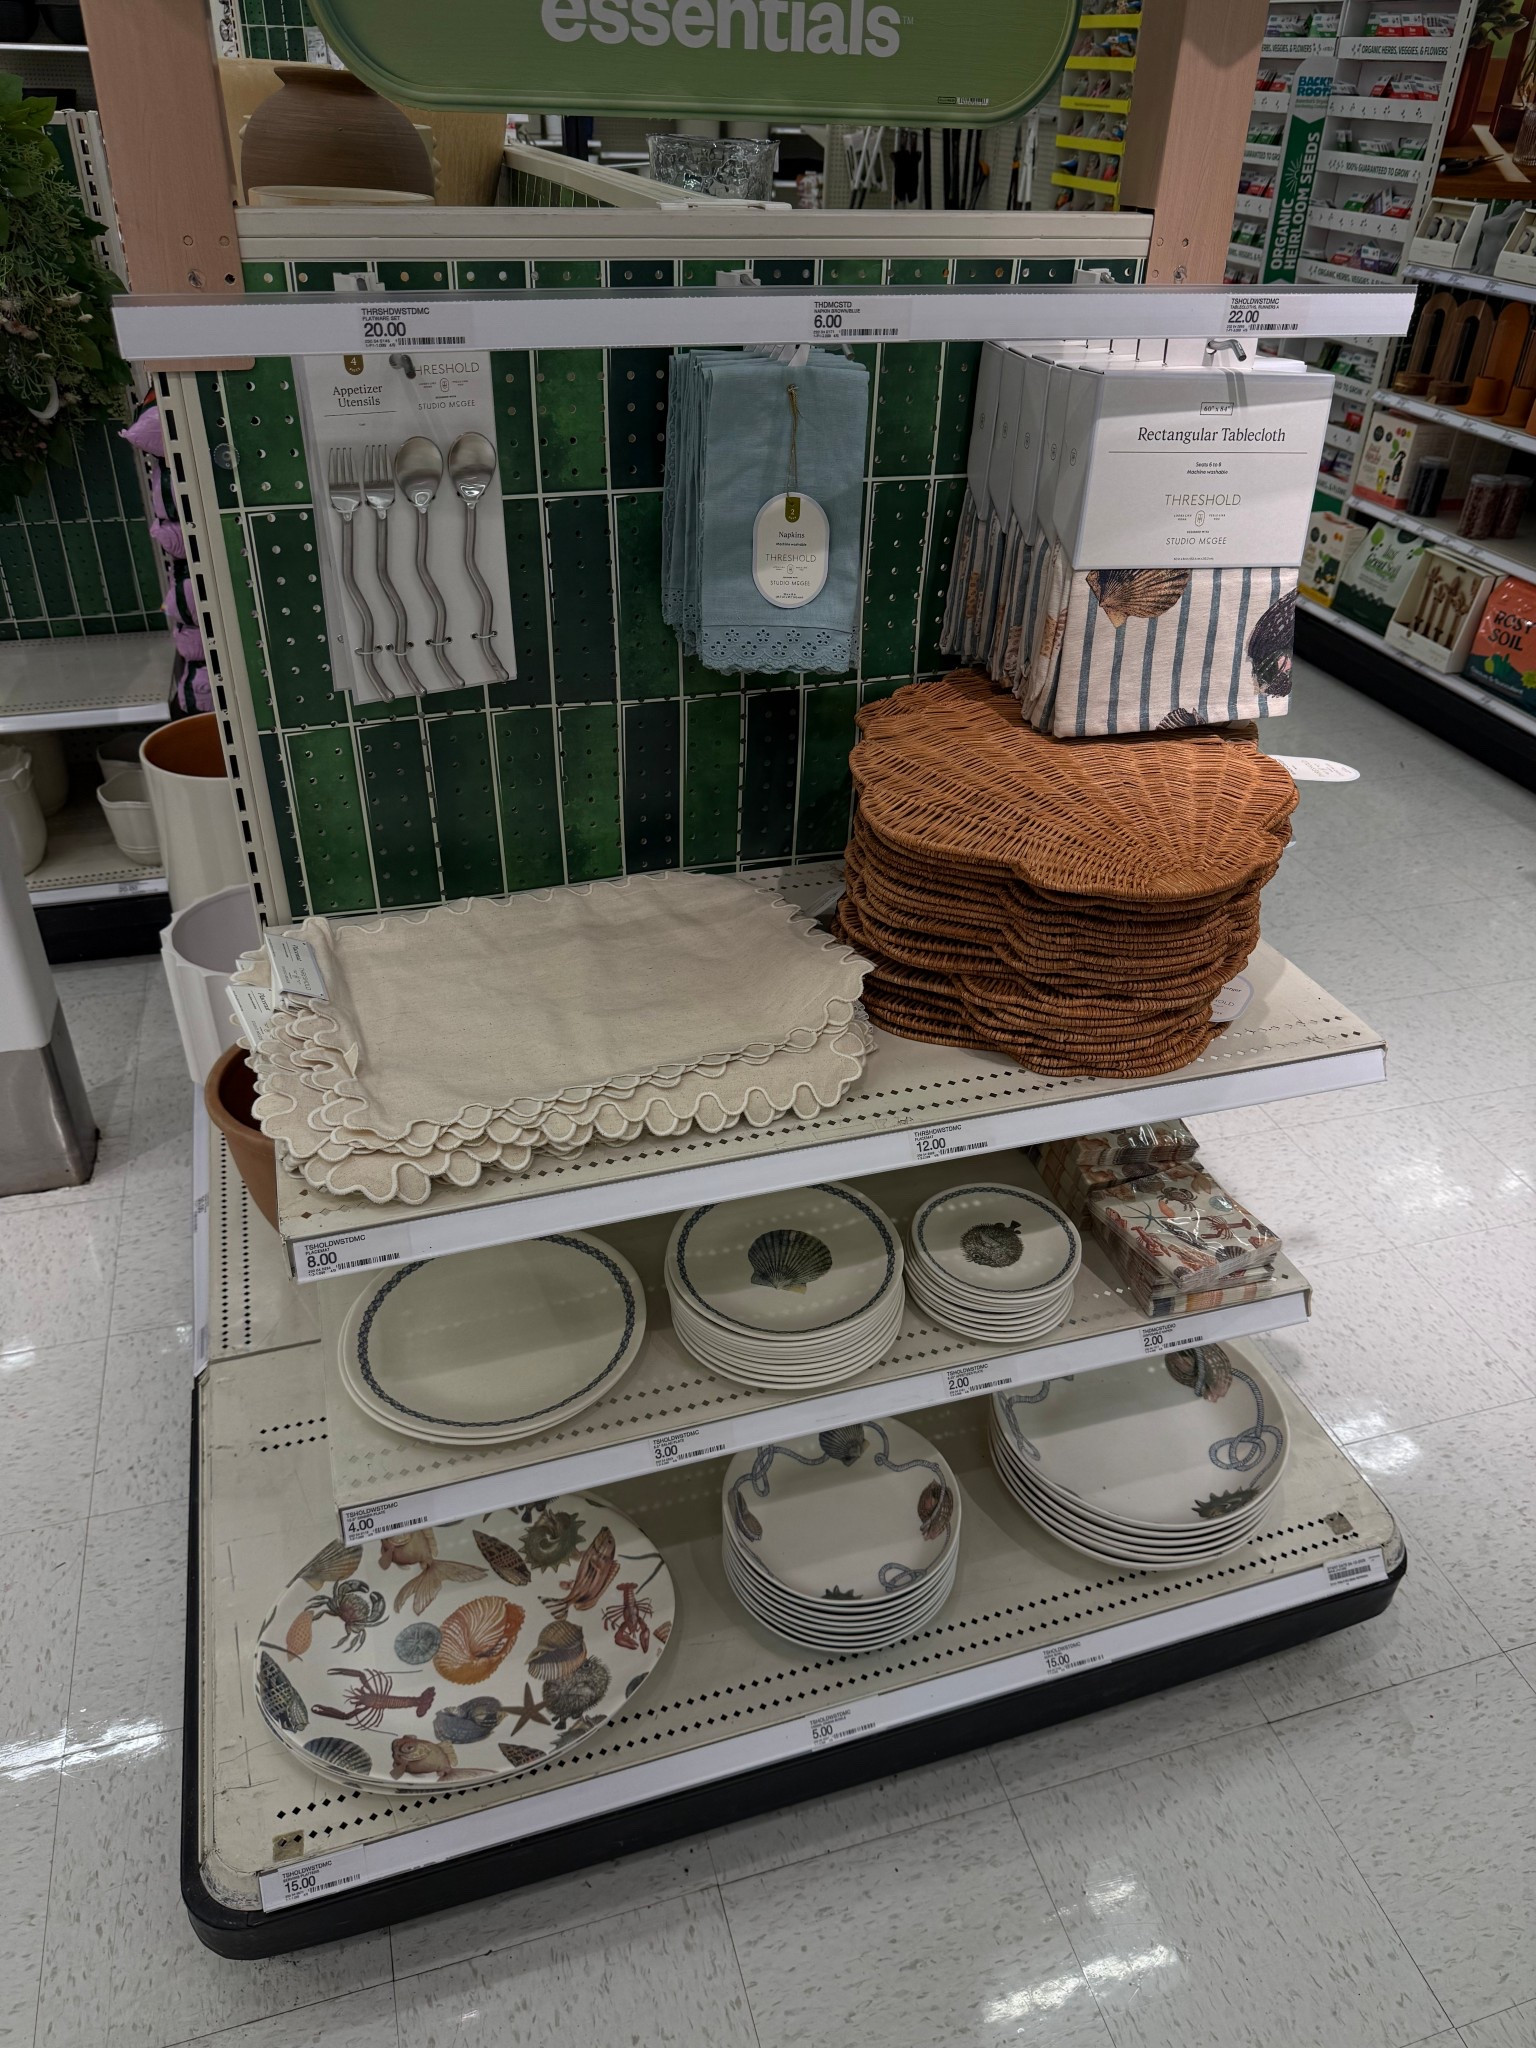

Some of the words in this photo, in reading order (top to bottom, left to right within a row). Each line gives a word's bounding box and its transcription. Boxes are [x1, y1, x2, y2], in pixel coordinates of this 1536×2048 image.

[541, 0, 900, 58] essentials
[1362, 45, 1381, 54] ORGANIC
[1424, 46, 1448, 55] FLOWERS
[1298, 76, 1326, 87] BACK
[1358, 163, 1387, 175] GUARANTEED
[1395, 167, 1410, 177] GROW
[1284, 189, 1310, 270] HEIRLOOM
[1301, 132, 1320, 185] SEEDS
[1271, 198, 1294, 270] ORGANIC
[361, 307, 430, 315] THRSHDWSTDMC
[1228, 310, 1259, 323] 22.00
[814, 315, 842, 328] 6.00
[364, 322, 406, 337] 20.00
[350, 356, 357, 366] 4
[415, 362, 480, 376] HRESHOLD
[333, 384, 382, 397] Appetizer
[339, 397, 381, 408] Utensils
[418, 402, 446, 411] STUDIO
[1138, 427, 1218, 444] Rectangular
[1221, 428, 1286, 442] Tablecloth
[1165, 494, 1242, 506] THRESHOLD
[779, 531, 805, 540] Napkins
[1166, 537, 1196, 545] STUDIO
[765, 553, 816, 563] THRESHOLD
[1488, 628, 1523, 652] SOIL
[916, 1138, 946, 1153] 12.00
[304, 1234, 366, 1251] TSHOLDWSTDMC
[305, 1248, 330, 1256] PLACEMAT
[307, 1252, 337, 1268] 8.00
[1144, 1335, 1163, 1347] 2.00
[948, 1377, 969, 1390] 2.00
[654, 1445, 678, 1459] 3.00
[348, 1518, 374, 1533] 4.00
[1046, 1654, 1070, 1669] 15.00
[812, 1725, 833, 1739] 5.00
[282, 1860, 332, 1879] TSHOLDWSTDMC
[284, 1875, 316, 1893] 15.00
